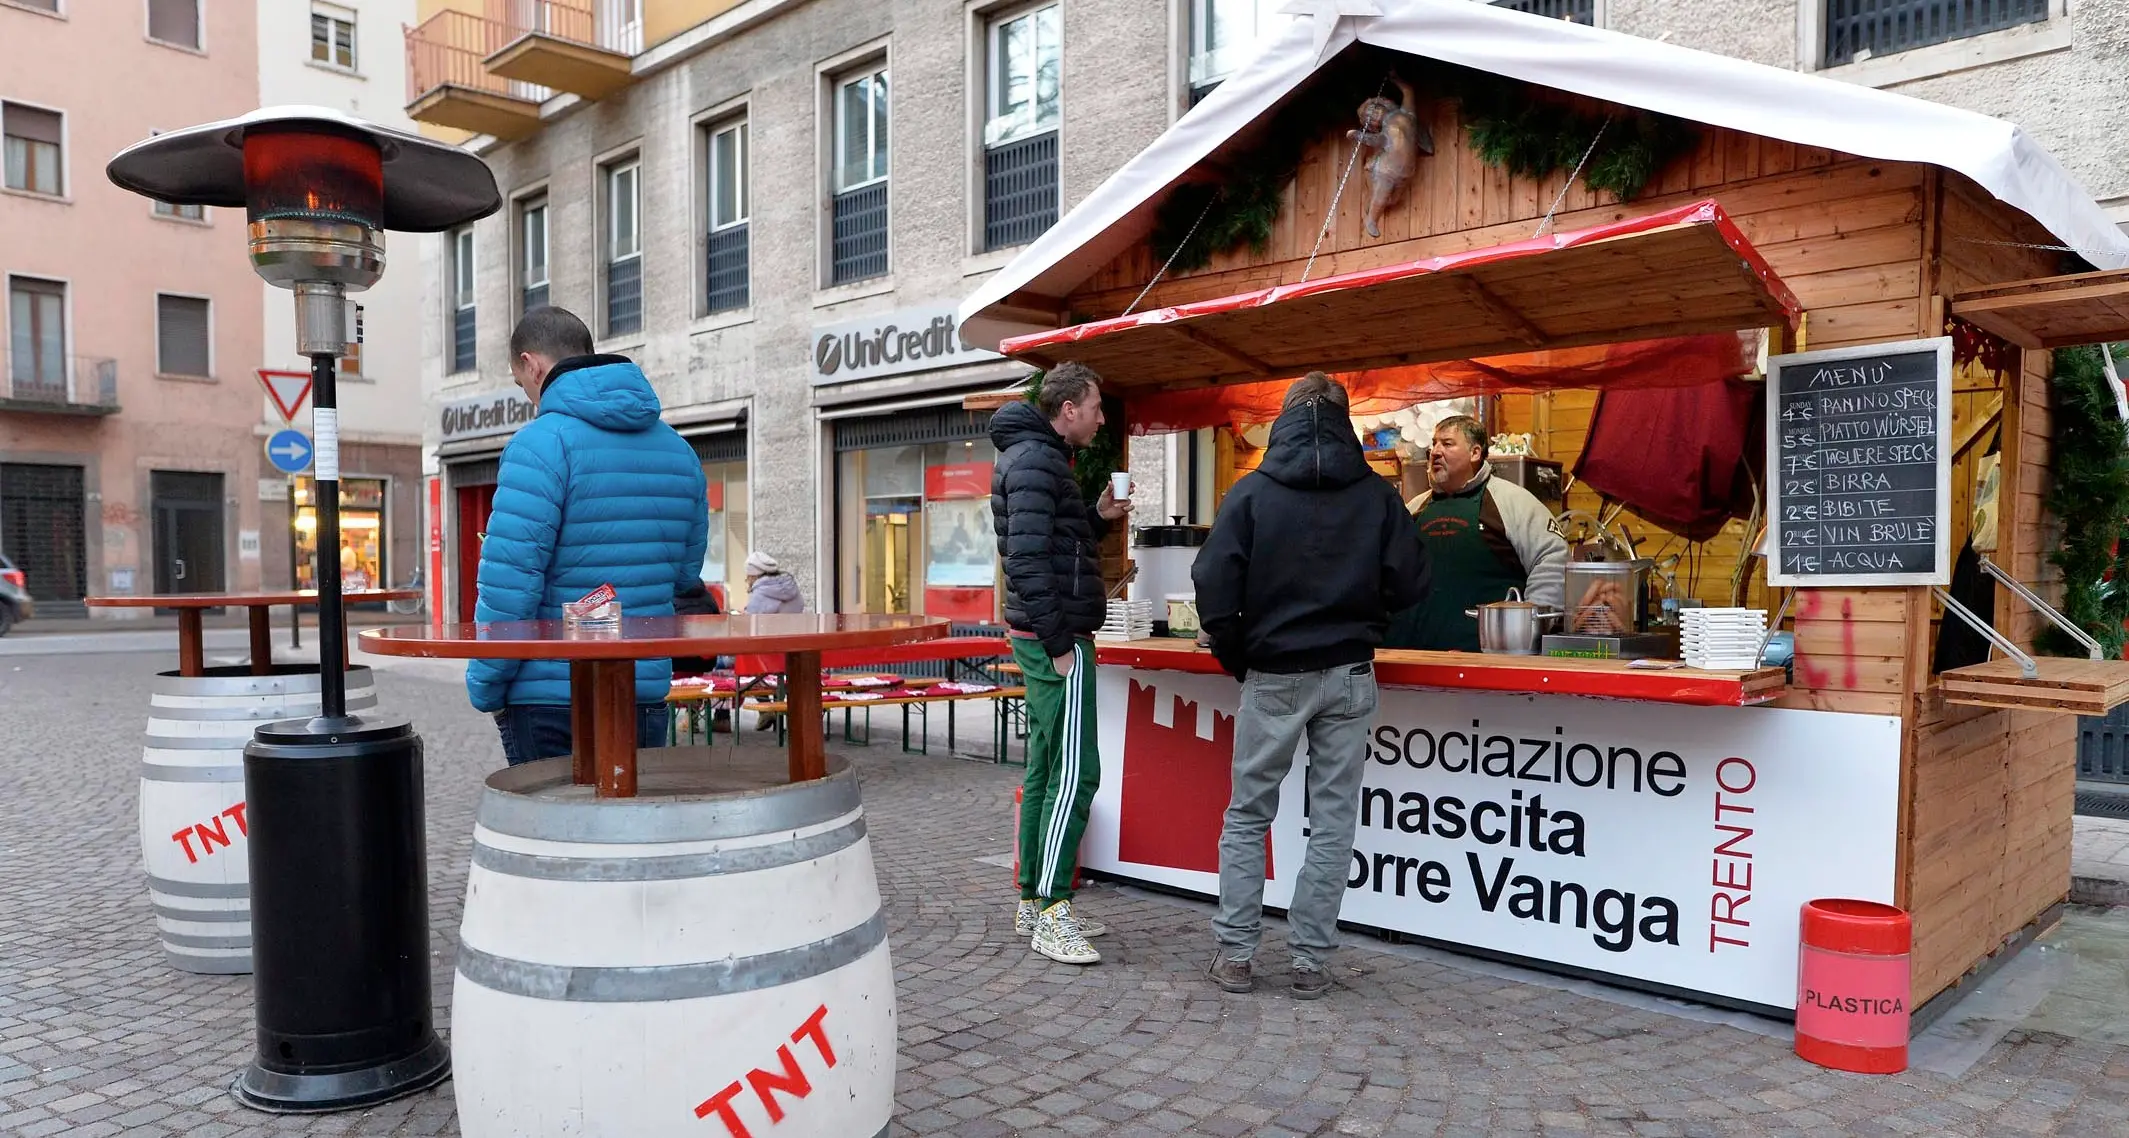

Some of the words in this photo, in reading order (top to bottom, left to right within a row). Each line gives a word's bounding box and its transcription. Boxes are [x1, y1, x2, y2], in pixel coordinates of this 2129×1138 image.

[844, 314, 955, 370] UniCredit
[454, 399, 505, 432] UniCredit
[1821, 392, 1889, 414] PANINO
[1891, 387, 1936, 412] SPECK
[1820, 421, 1869, 442] PIATTO
[1873, 412, 1935, 438] WÜRSTEL
[1813, 446, 1887, 465] TAGLIERE
[1889, 443, 1936, 462] SPECK
[1824, 472, 1891, 491] BIRRA
[1823, 499, 1896, 517] BIBITE
[1824, 525, 1860, 543] VIN
[1828, 551, 1903, 570] ACQUA
[1306, 719, 1687, 797] sociazione
[1304, 765, 1586, 858] nascita
[172, 801, 248, 864] TNT
[1709, 757, 1757, 953] TRENTO
[1465, 851, 1680, 953] Vanga
[1806, 989, 1904, 1015] PLASTICA
[694, 1003, 837, 1138] TNT
